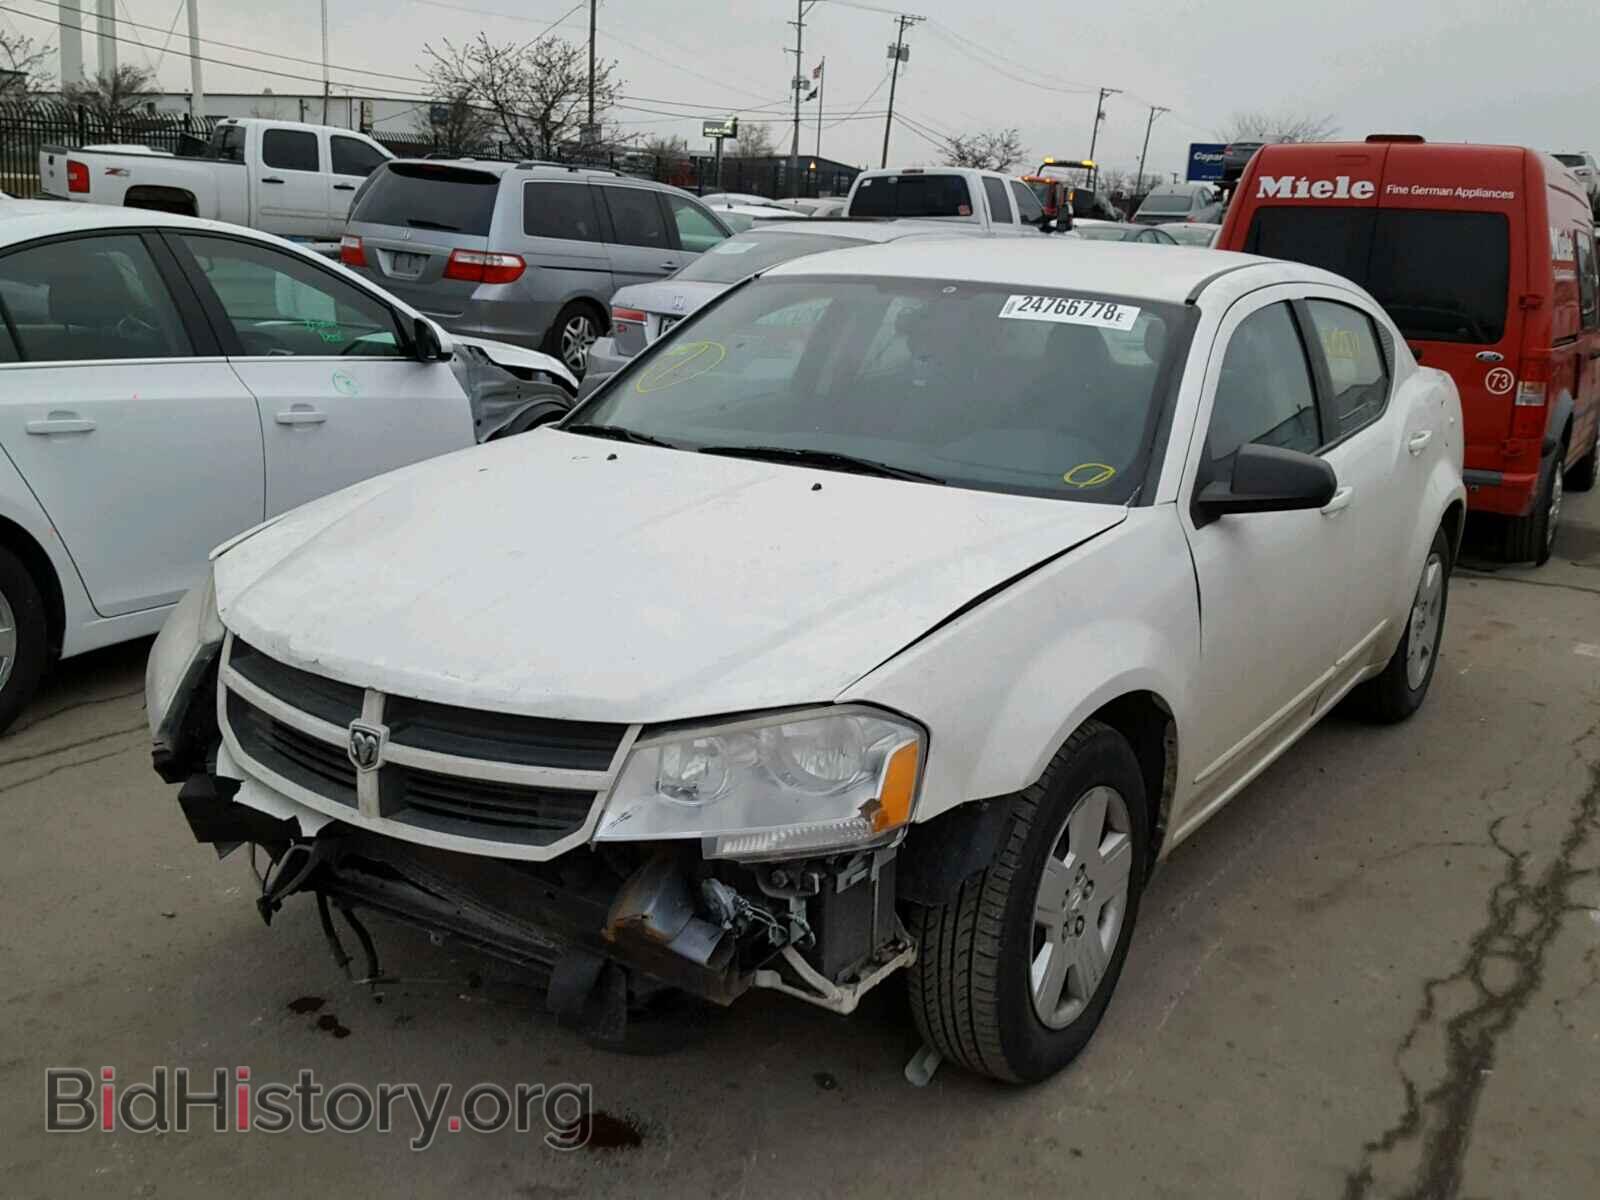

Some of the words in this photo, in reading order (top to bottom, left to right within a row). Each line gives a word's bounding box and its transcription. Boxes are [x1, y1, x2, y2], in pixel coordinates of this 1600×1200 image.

[1193, 152, 1224, 162] Copar
[1256, 175, 1376, 199] Miele
[1386, 184, 1409, 194] Fine
[1410, 185, 1453, 196] German
[1455, 187, 1515, 199] Appliances
[1491, 373, 1509, 389] 73
